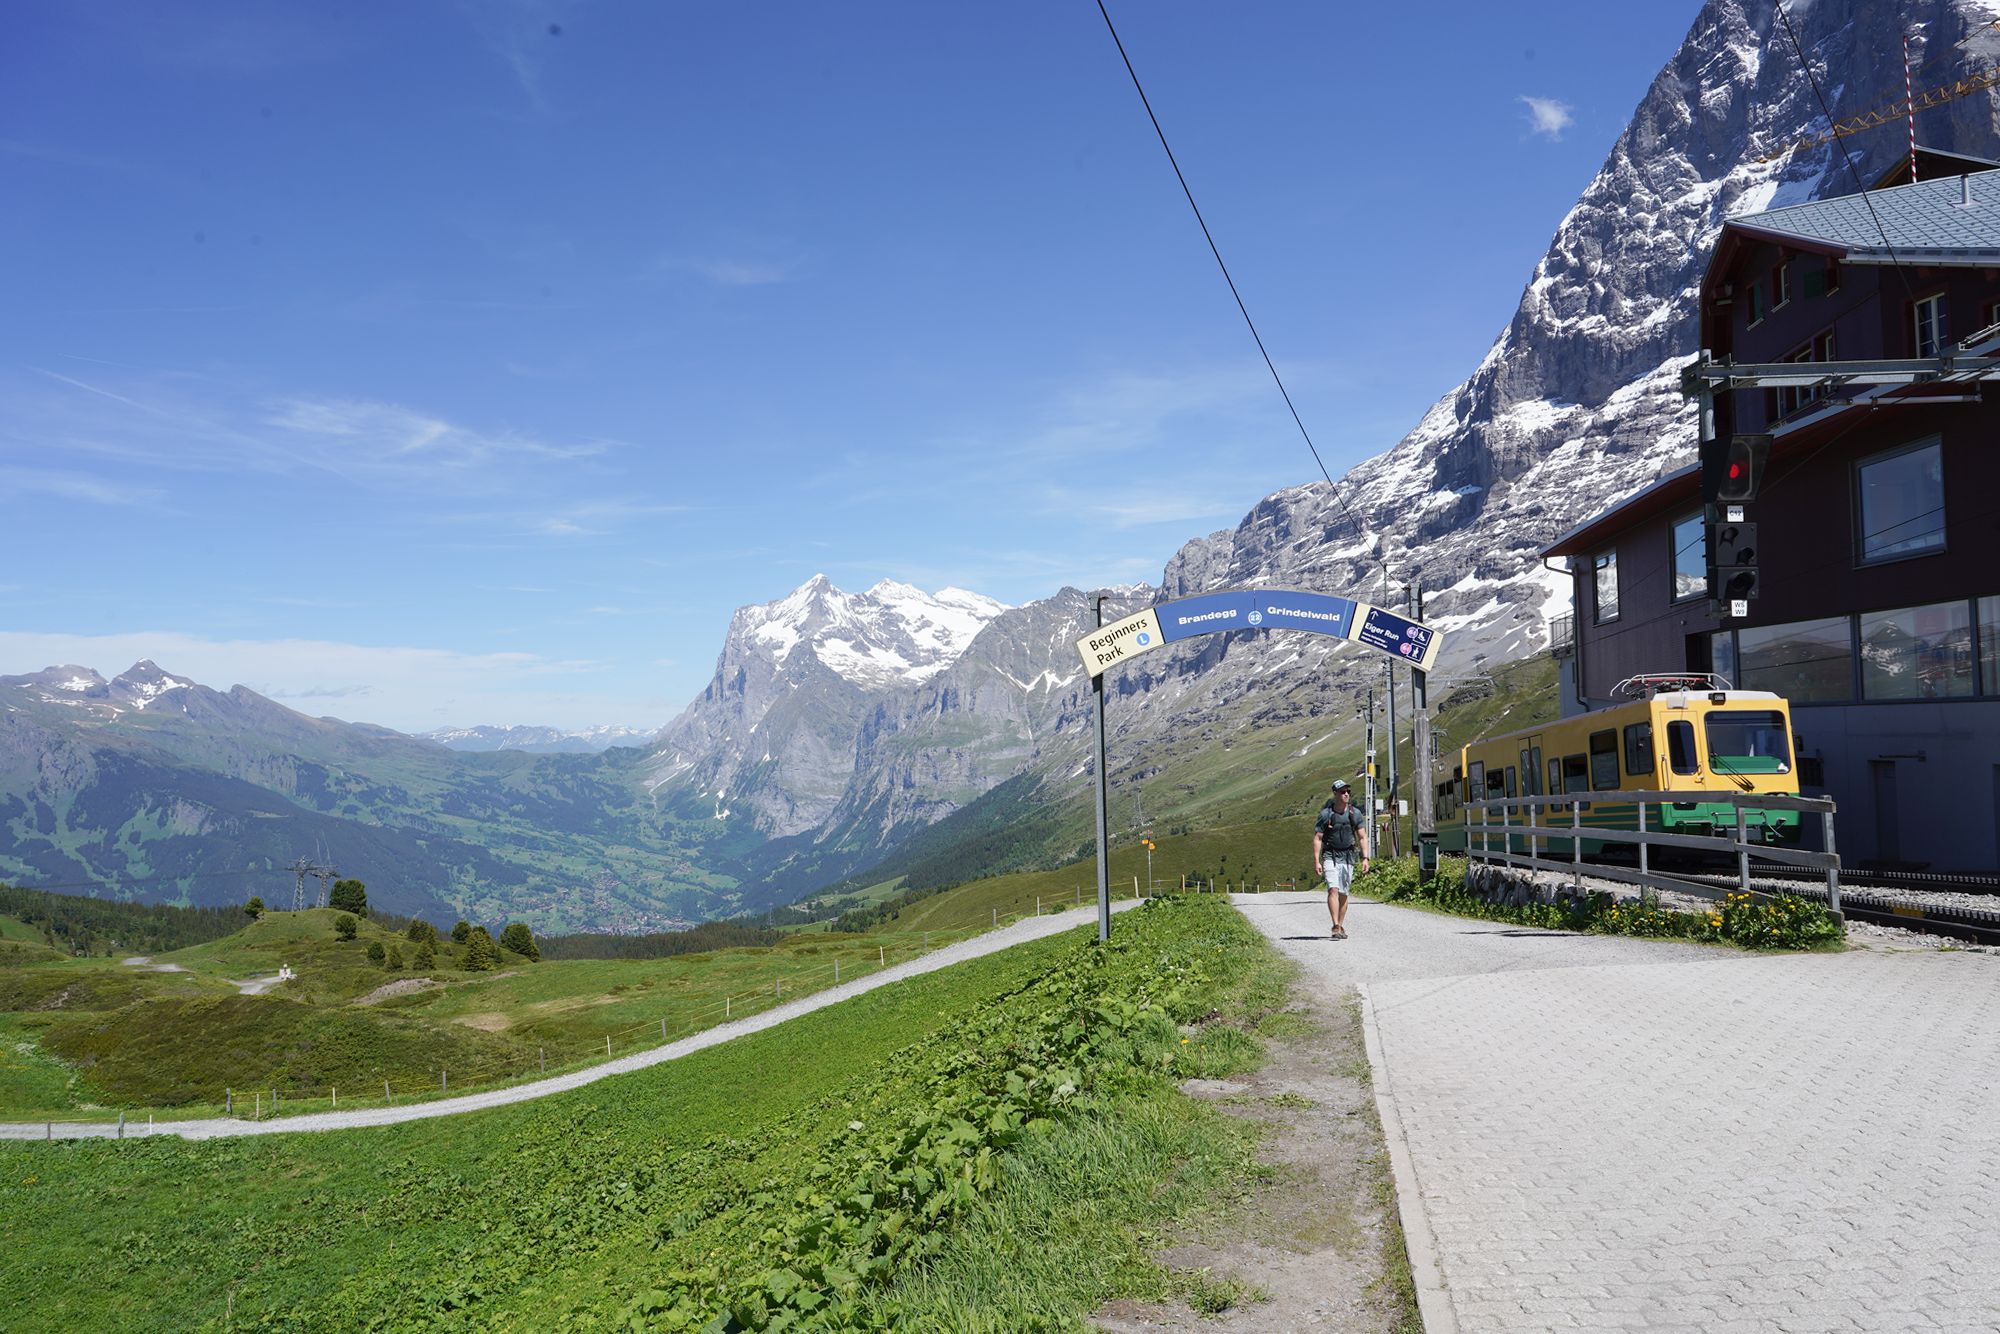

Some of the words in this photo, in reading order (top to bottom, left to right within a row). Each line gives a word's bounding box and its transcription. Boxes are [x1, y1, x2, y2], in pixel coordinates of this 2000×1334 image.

[1178, 609, 1237, 625] Brandegg
[1267, 606, 1340, 621] Grindelwald
[1089, 618, 1148, 651] Beginners
[1364, 622, 1384, 636] Eiger
[1384, 629, 1400, 641] Run
[1097, 646, 1124, 665] Park
